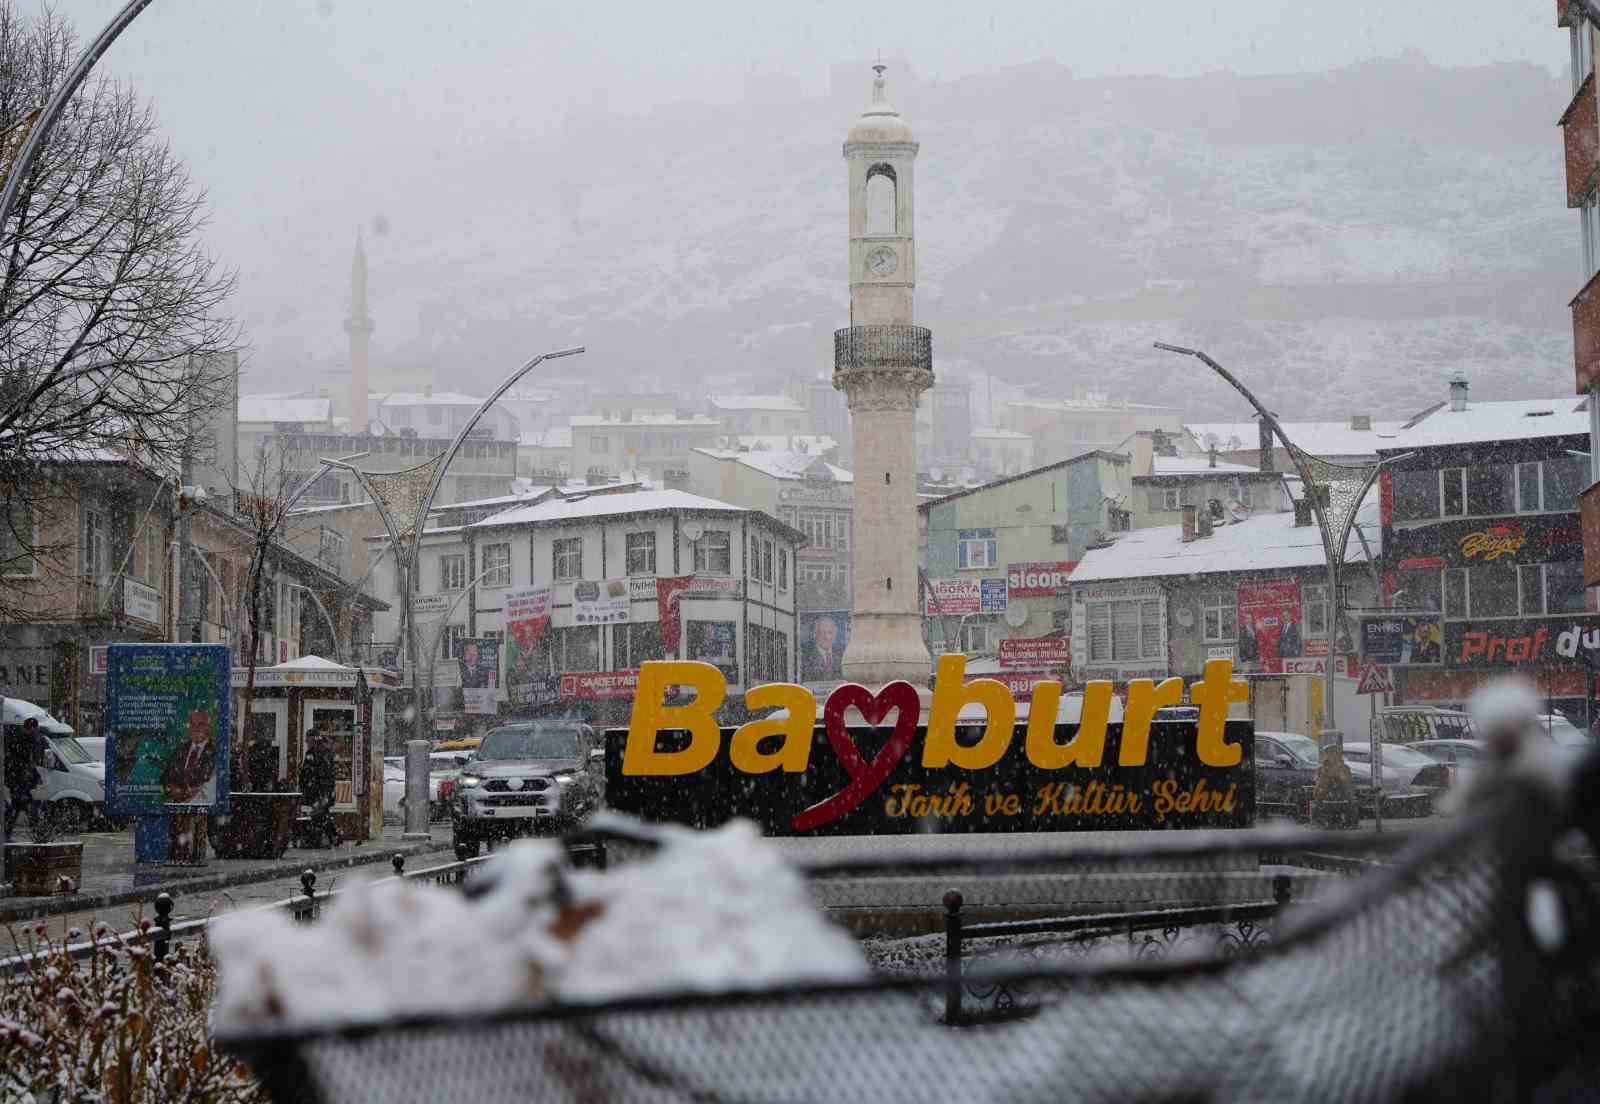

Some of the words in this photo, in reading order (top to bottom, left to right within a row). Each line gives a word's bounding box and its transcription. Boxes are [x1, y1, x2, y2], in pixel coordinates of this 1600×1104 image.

[1009, 572, 1066, 588] SİGOR
[931, 581, 980, 594] İGORTA
[1286, 660, 1345, 673] ECZAE
[885, 783, 975, 818] Tarih
[985, 794, 1022, 817] ve
[1033, 781, 1142, 816] Kültür
[1152, 779, 1238, 823] Şehri
